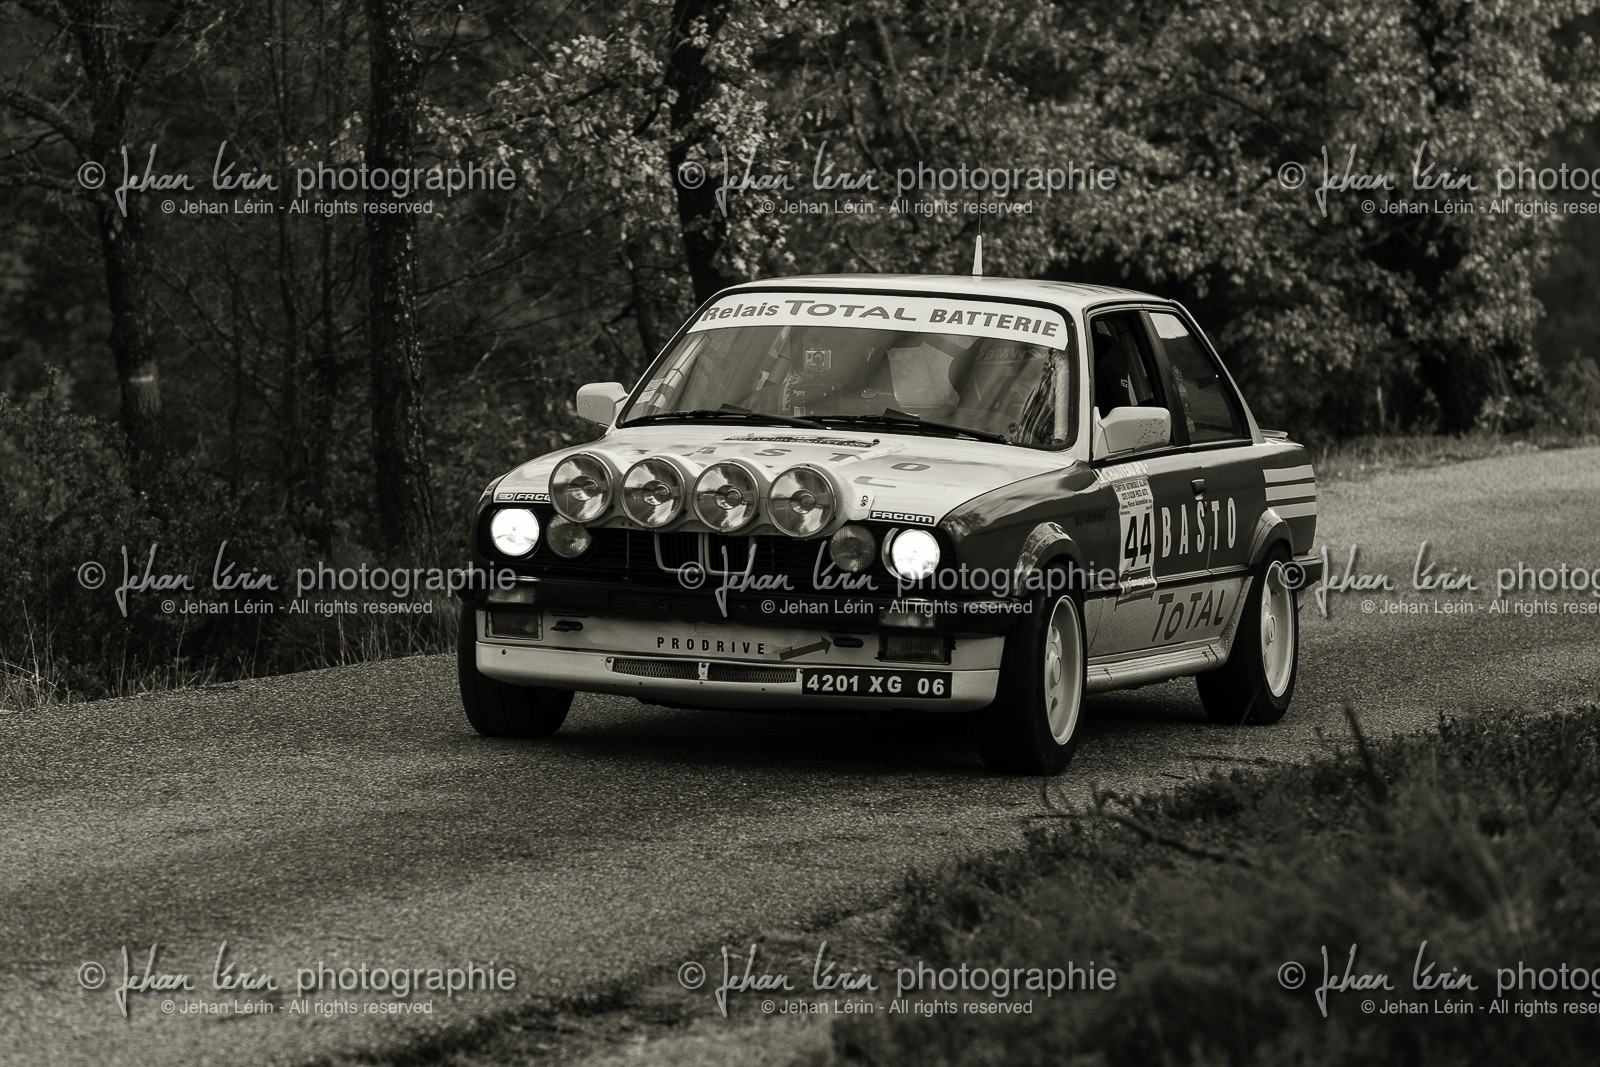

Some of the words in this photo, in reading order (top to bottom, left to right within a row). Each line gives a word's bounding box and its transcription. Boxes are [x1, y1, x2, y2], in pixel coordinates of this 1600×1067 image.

[701, 301, 780, 322] Relais
[785, 299, 918, 322] TOTAL
[929, 308, 1060, 338] BATTERIE
[636, 446, 931, 472] ASTO
[515, 493, 551, 502] FACO
[871, 511, 934, 524] FACOM
[1161, 497, 1237, 559] BASTO
[1123, 512, 1152, 568] 44
[656, 636, 766, 655] PRODRIVE
[806, 674, 860, 692] 4201
[868, 675, 903, 694] XG
[917, 677, 945, 696] 06
